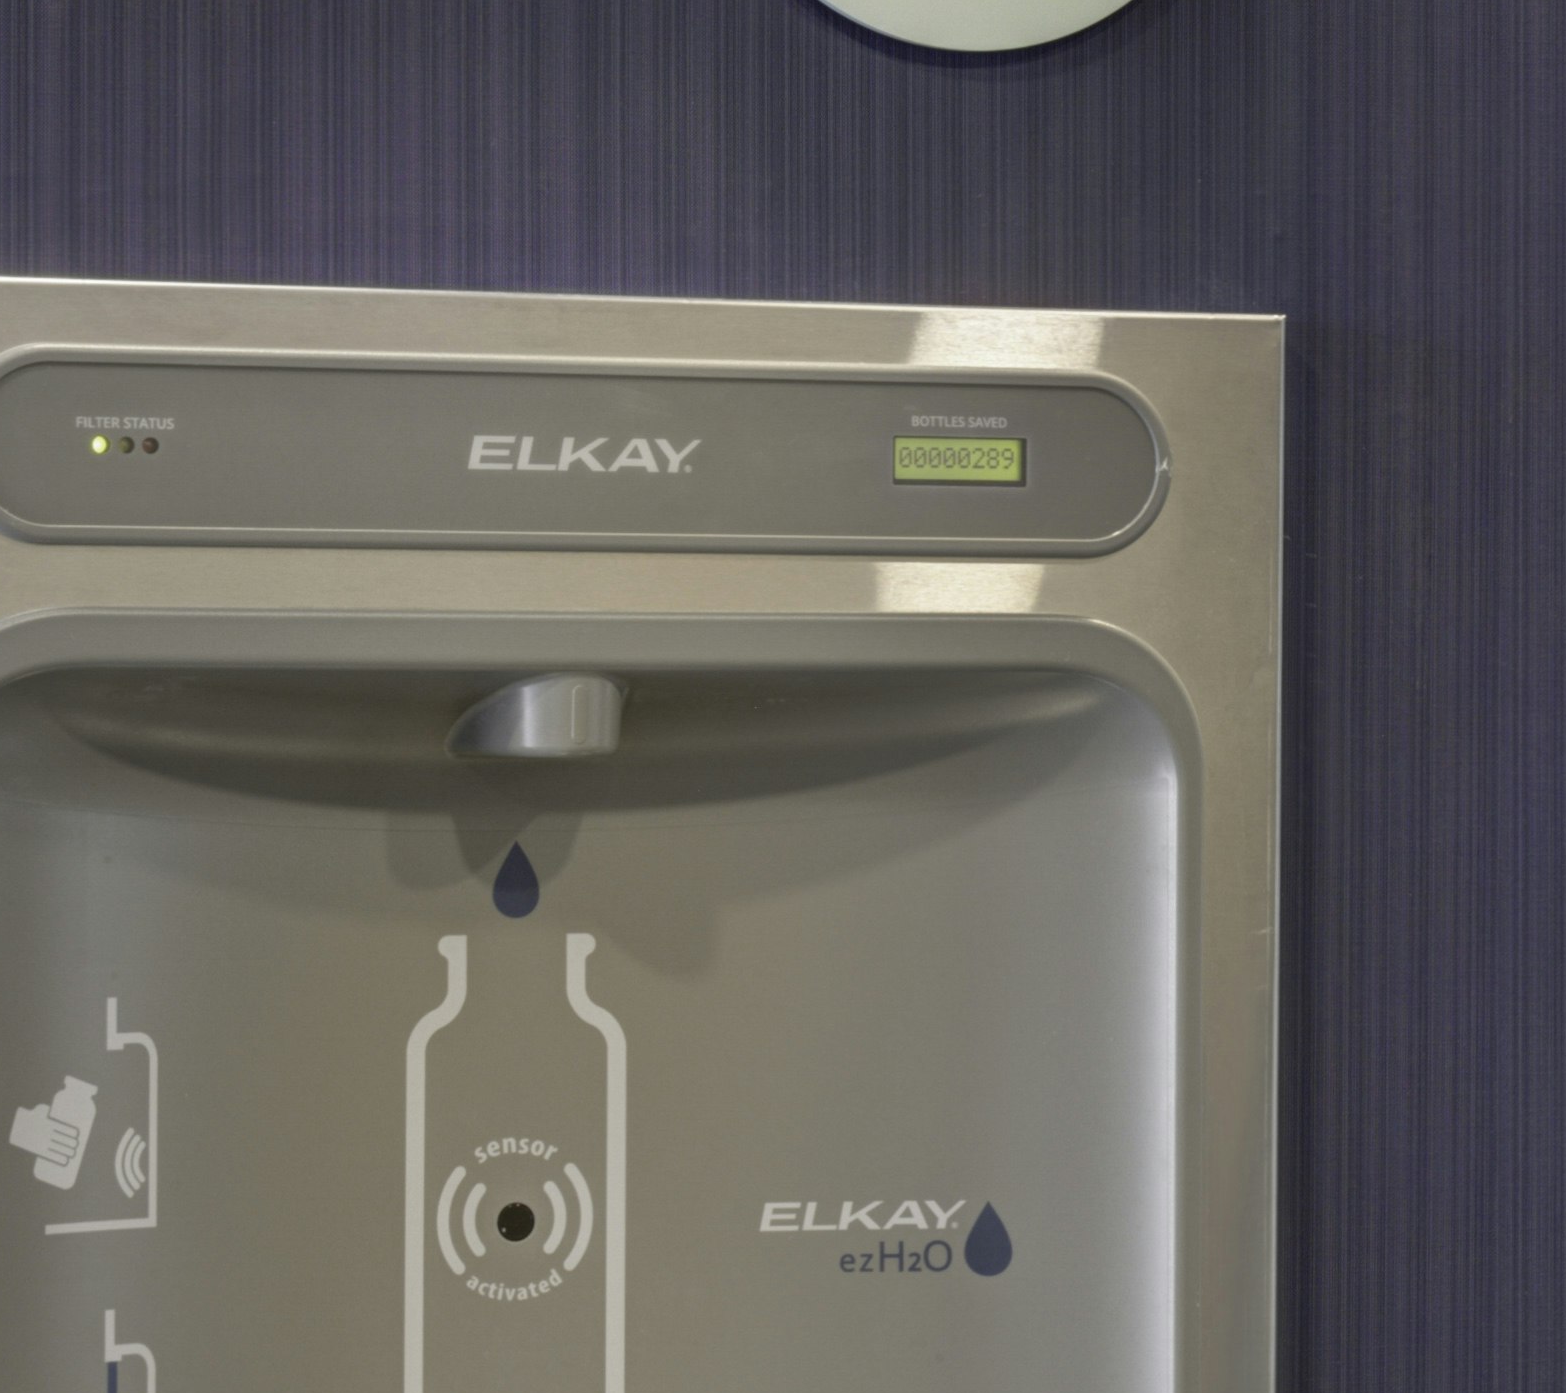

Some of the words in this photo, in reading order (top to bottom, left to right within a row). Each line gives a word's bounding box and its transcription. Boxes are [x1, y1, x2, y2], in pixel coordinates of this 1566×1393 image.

[75, 416, 120, 428] FILTER
[123, 417, 175, 430] STATUS
[911, 415, 966, 428] BOTTLES
[967, 416, 1008, 429] SAVED
[899, 446, 1014, 469] 00000289
[474, 1137, 558, 1164] sensor
[839, 1239, 953, 1273] ezH2O
[466, 1268, 562, 1301] activated
